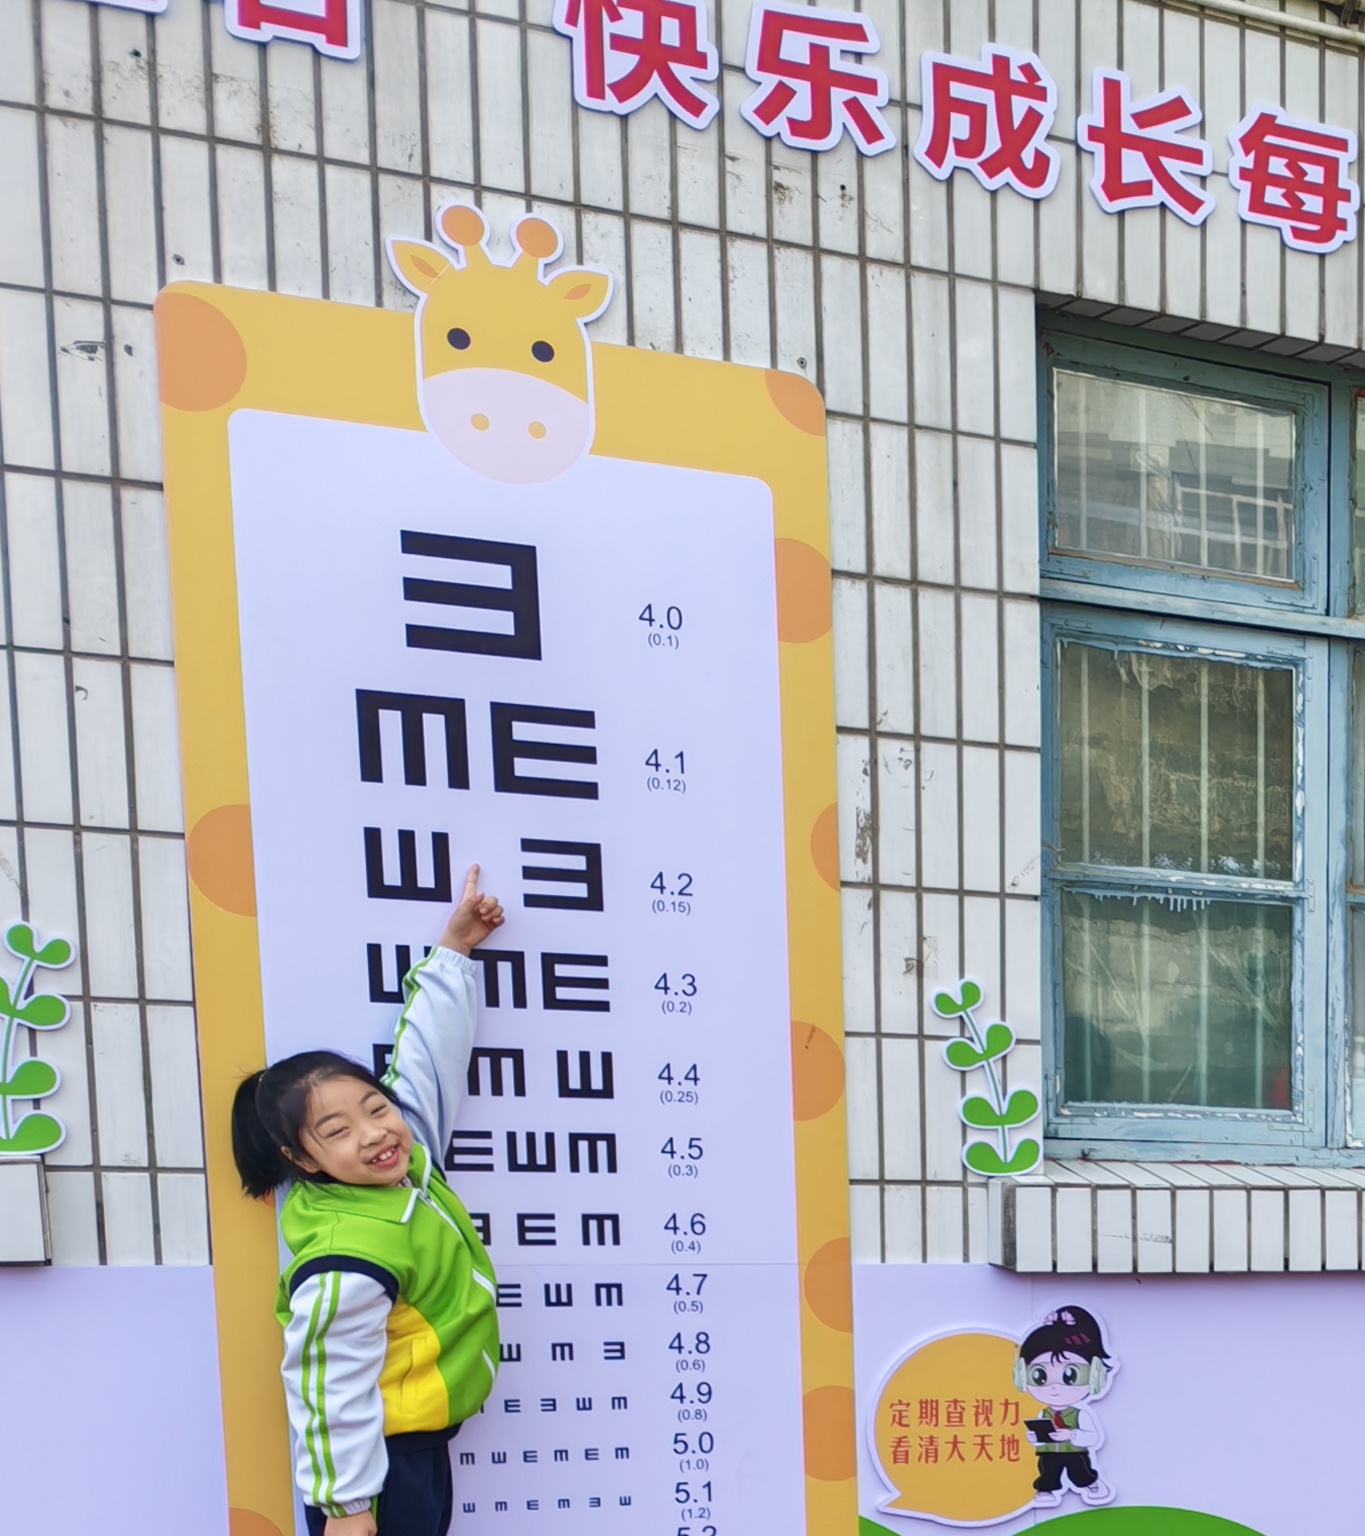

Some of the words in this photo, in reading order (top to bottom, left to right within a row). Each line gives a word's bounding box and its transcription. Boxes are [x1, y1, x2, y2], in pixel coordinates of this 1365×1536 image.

[639, 603, 683, 630] 4.0
[648, 633, 679, 650] (0.1)
[645, 749, 685, 774] 4.1
[647, 777, 686, 794] (0.12)
[650, 871, 693, 896] 4.2
[652, 899, 691, 915] (0.15)
[654, 972, 697, 996] 4.3
[662, 1001, 692, 1015] (0.2)
[658, 1062, 700, 1086] 4.4
[660, 1091, 699, 1105] (0.25)
[661, 1136, 703, 1160] 4.5
[668, 1164, 698, 1178] (0.3)
[664, 1213, 706, 1235] 4.6
[671, 1241, 701, 1254] (0.4)
[666, 1274, 708, 1296] 4.7
[674, 1301, 703, 1314] (0.5)
[668, 1332, 710, 1354] 4.8
[676, 1359, 705, 1372] (0.6)
[670, 1382, 712, 1404] 4.9
[678, 1409, 707, 1422] (0.8)
[889, 1398, 1020, 1428] 定期查视力
[673, 1431, 714, 1455] 5.0
[889, 1434, 1020, 1464] 看清大天地
[680, 1459, 709, 1473] (1.0)
[675, 1481, 712, 1503] 5.1
[681, 1508, 710, 1521] (1.2)
